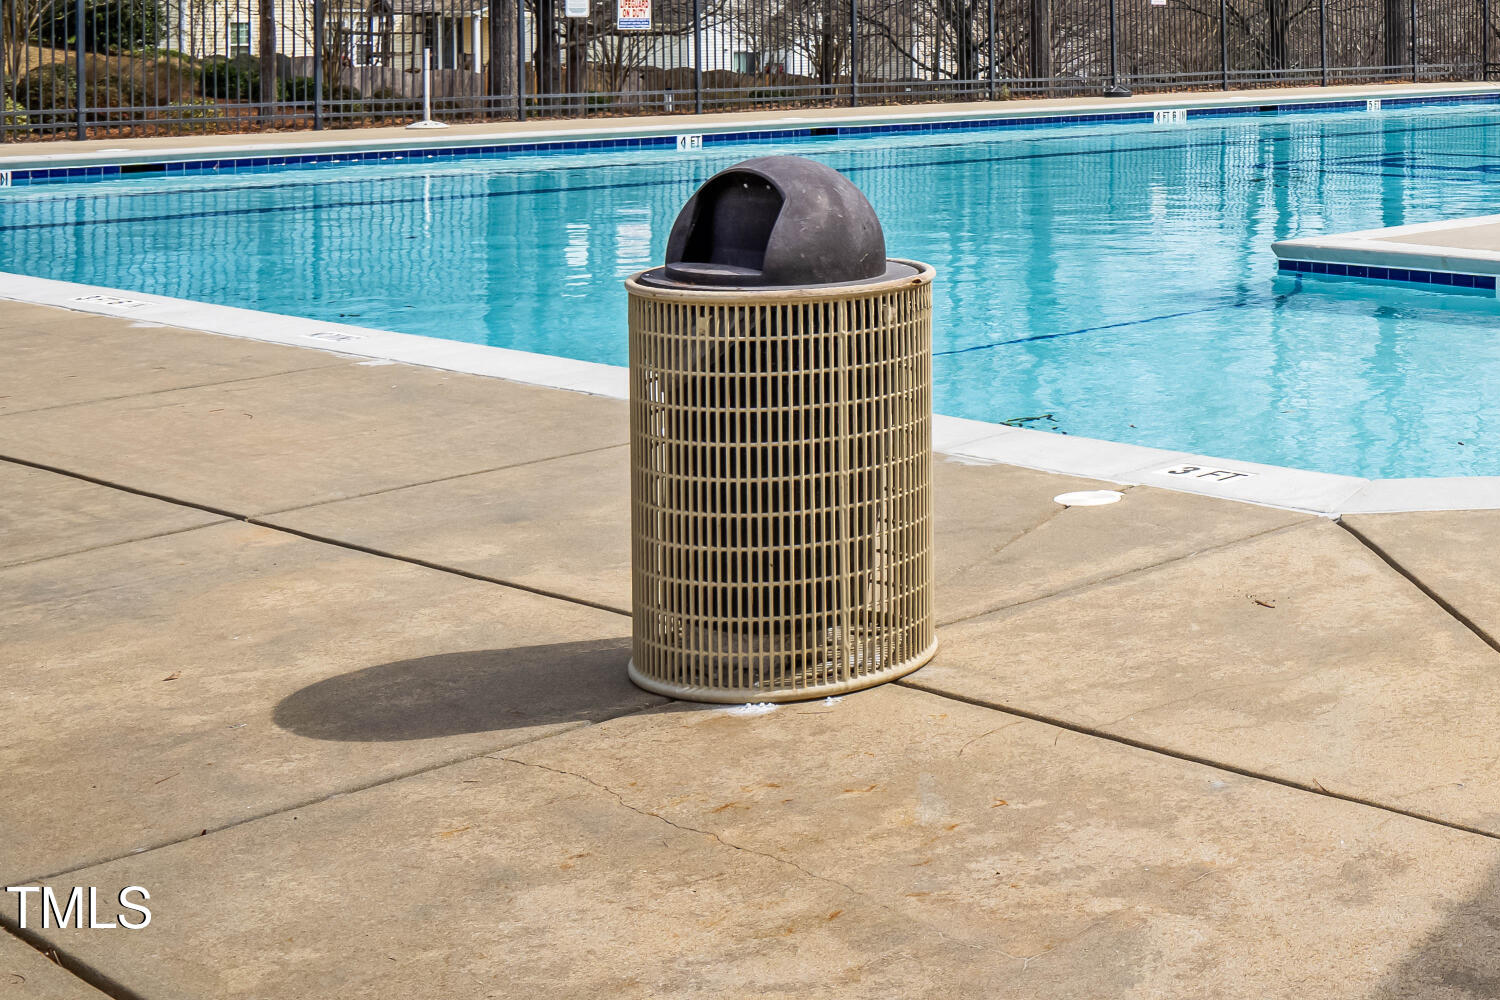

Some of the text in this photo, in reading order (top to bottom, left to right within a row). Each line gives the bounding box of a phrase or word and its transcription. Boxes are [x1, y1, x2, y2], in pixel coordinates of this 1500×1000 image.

[620, 0, 649, 9] LIFEGUARD
[622, 8, 646, 18] ON DUTY
[1167, 466, 1249, 482] 3 FT
